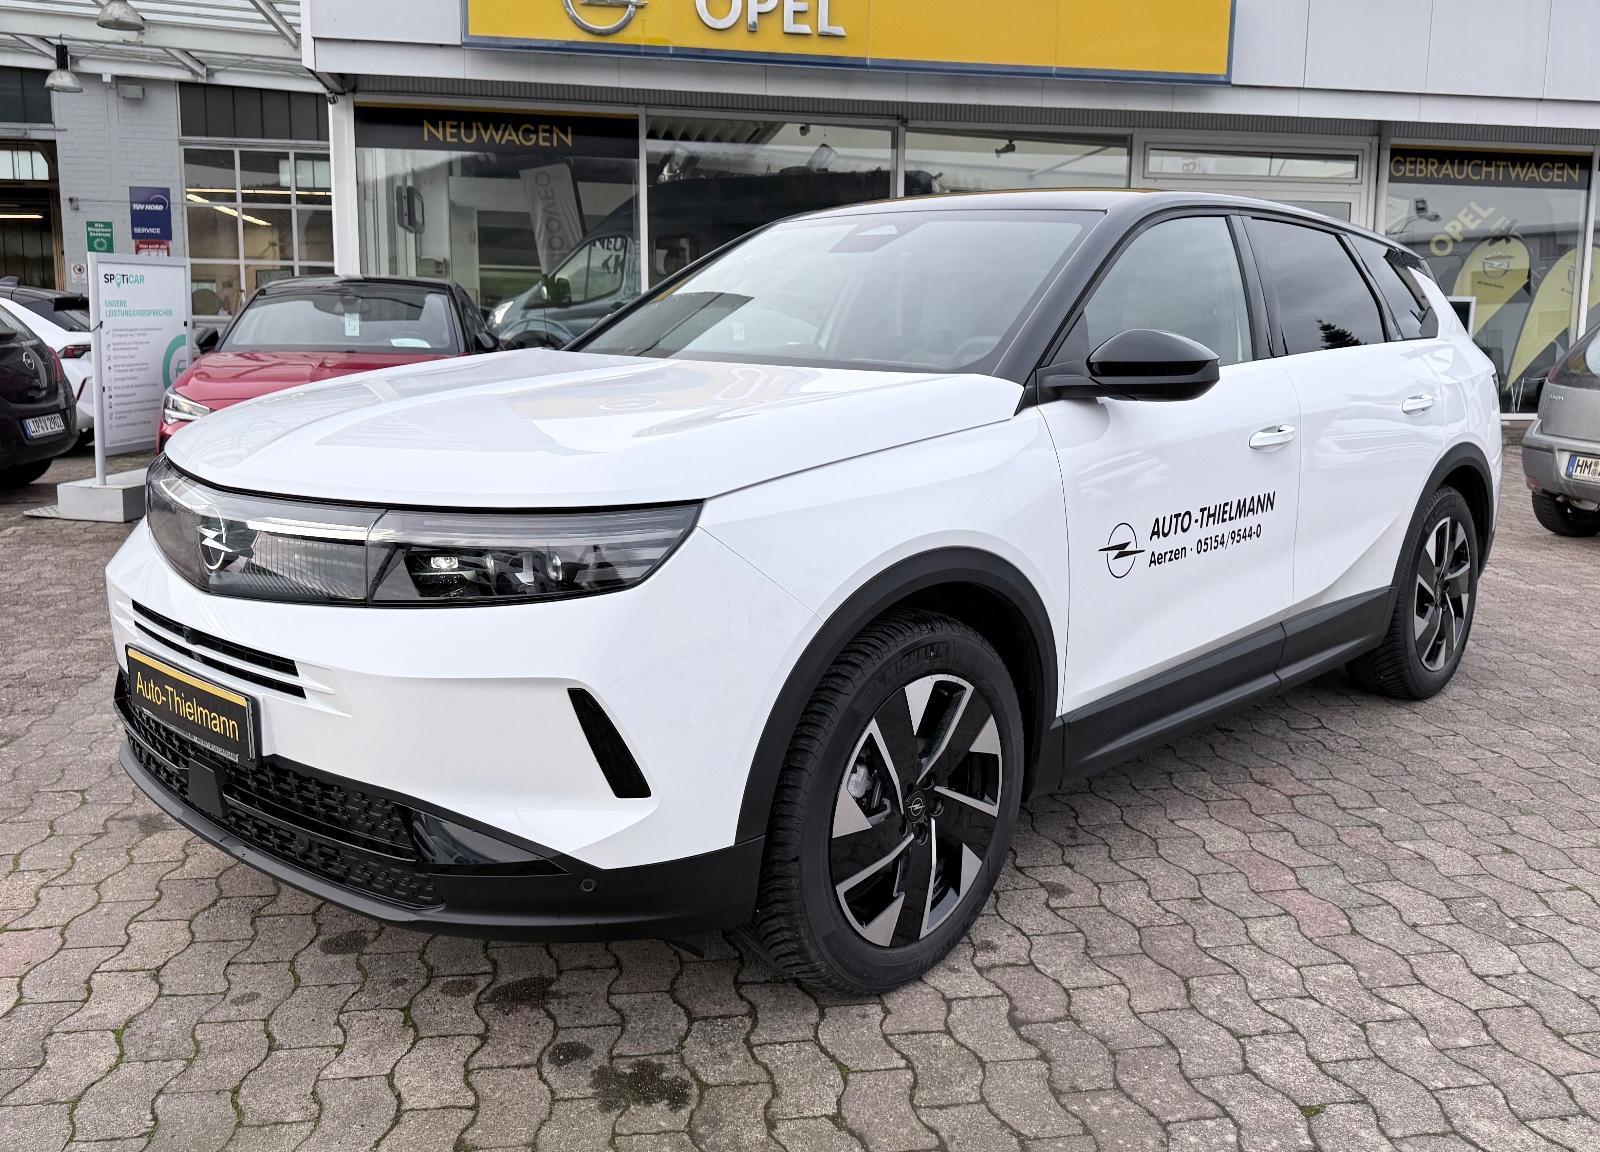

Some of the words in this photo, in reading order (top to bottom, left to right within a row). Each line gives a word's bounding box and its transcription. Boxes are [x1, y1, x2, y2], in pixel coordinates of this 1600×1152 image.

[695, 0, 847, 37] OPEL
[423, 119, 573, 147] NEUWAGEN
[1390, 155, 1580, 183] GEBRAUCHTWAGEN
[133, 226, 161, 234] SERVICE
[1429, 201, 1496, 257] OPEL
[104, 299, 128, 308] UNSERE
[1574, 457, 1593, 476] HM
[1148, 550, 1187, 568] Aerzen
[1196, 523, 1262, 555] 05154/9544-0
[136, 671, 239, 741] Auto-Thielmann
